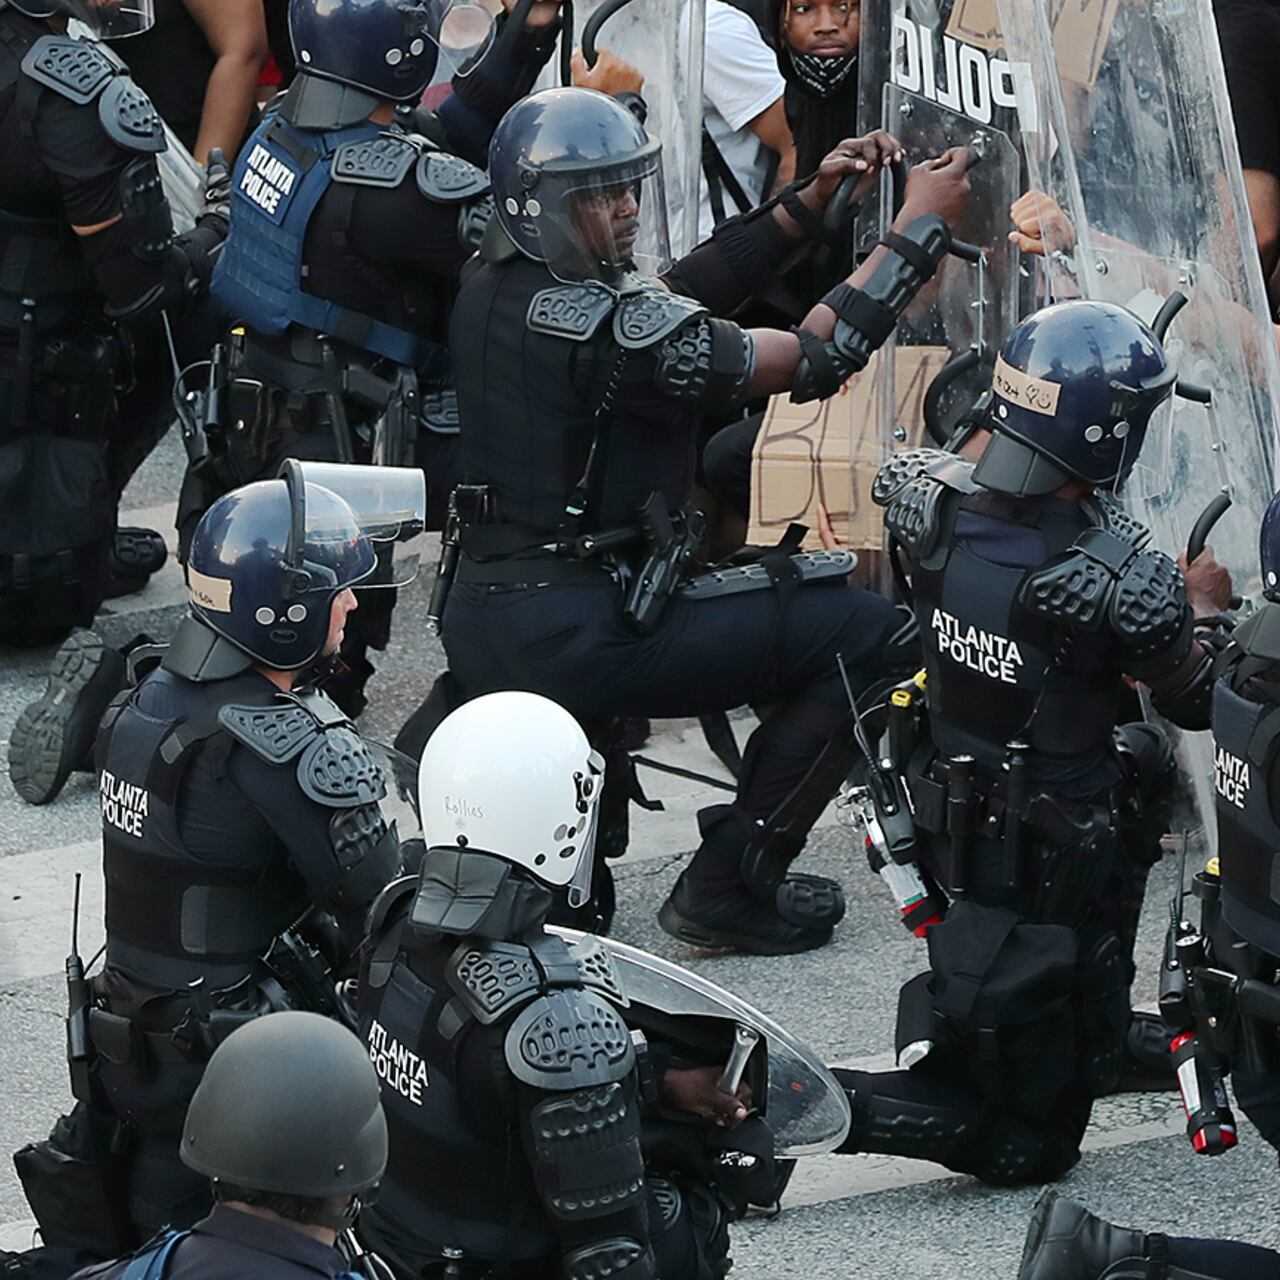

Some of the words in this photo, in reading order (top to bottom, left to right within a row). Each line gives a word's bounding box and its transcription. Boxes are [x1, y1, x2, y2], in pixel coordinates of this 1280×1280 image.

[239, 167, 281, 215] POLICE
[246, 143, 295, 196] ATLANTA
[931, 607, 1024, 666] ATLANTA
[938, 631, 1018, 683] POLICE
[100, 769, 148, 817] ATLANTA
[102, 793, 143, 838] POLICE
[367, 1019, 429, 1087] ATLANTA
[369, 1047, 423, 1106] POLICE
